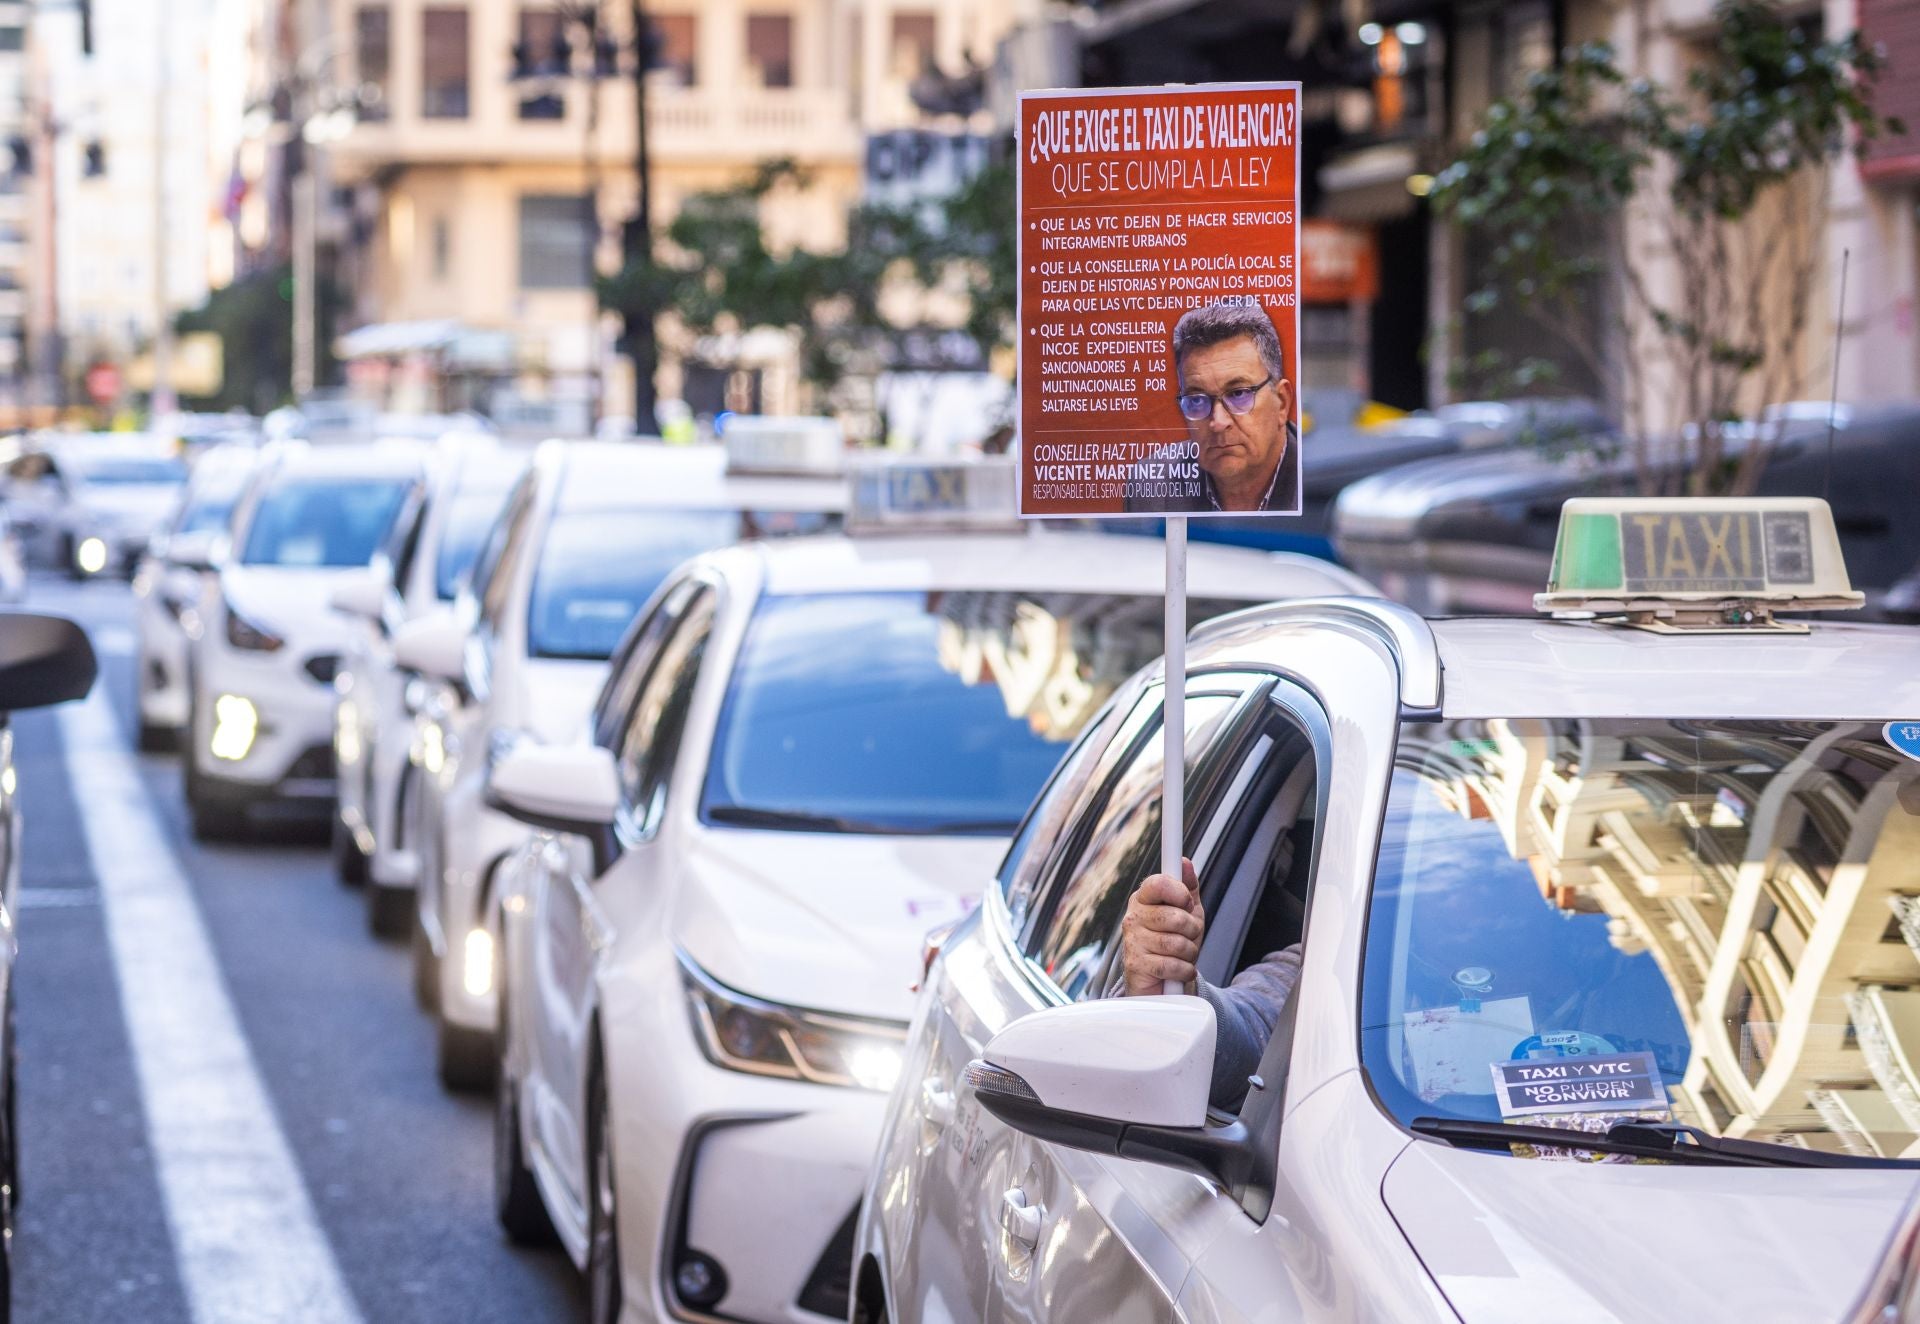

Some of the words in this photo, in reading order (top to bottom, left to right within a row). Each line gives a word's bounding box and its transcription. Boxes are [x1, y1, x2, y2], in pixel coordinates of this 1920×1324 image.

[1030, 110, 1071, 164] ¿QUE
[1075, 108, 1119, 153] EXIGE
[1123, 107, 1140, 151] EL
[1143, 106, 1179, 150] TAXI
[1183, 105, 1204, 149] DE
[1207, 102, 1294, 148] VALENCIA?
[1052, 162, 1092, 198] QUE
[1098, 161, 1119, 192] SE
[1125, 159, 1205, 191] CUMPLA
[1211, 158, 1233, 188] LA
[1239, 156, 1272, 187] LEY
[1040, 218, 1065, 232] QUE
[1071, 217, 1091, 231] LAS
[1096, 216, 1118, 230] VTC
[1124, 215, 1160, 229] DEJEN
[1166, 215, 1182, 228] DE
[1188, 213, 1227, 227] HACER
[1232, 211, 1292, 226] SERVICIOS
[1042, 235, 1129, 250] INTEGRAMENTE
[1132, 234, 1187, 248] URBANOS
[1040, 262, 1064, 276] QUE
[1068, 261, 1082, 274] LA
[1085, 259, 1160, 273] CONSELLERIA
[1163, 258, 1171, 271] Y
[1173, 258, 1187, 271] LA
[1191, 254, 1236, 270] POLICÍA
[1239, 256, 1275, 269] LOCAL
[1279, 255, 1292, 268] SE
[1042, 280, 1077, 294] DEJEN
[1080, 280, 1095, 293] DE
[1099, 278, 1157, 292] HISTORIAS
[1159, 278, 1167, 290] Y
[1170, 276, 1219, 290] PONGAN
[1222, 276, 1244, 289] LOS
[1247, 274, 1292, 288] MEDIOS
[1041, 299, 1070, 312] PARA
[1073, 298, 1097, 313] QUE
[1100, 298, 1120, 311] LAS
[1123, 297, 1145, 311] VTC
[1148, 296, 1184, 310] DEJEN
[1186, 296, 1201, 309] DE
[1204, 295, 1243, 308] HACER
[1246, 294, 1261, 307] DE
[1264, 293, 1295, 307] TAXIS
[1040, 323, 1064, 338] QUE
[1071, 323, 1084, 336] LA
[1090, 321, 1166, 336] CONSELLERIA
[1042, 342, 1079, 356] INCOE
[1087, 340, 1166, 355] EXPEDIENTES
[1042, 360, 1126, 375] SANCIONADORES
[1133, 359, 1140, 373] A
[1148, 359, 1166, 372] LAS
[1042, 379, 1136, 393] MULTINACIONALES
[1145, 378, 1166, 391] POR
[1042, 398, 1087, 413] SALTARSE
[1090, 398, 1108, 412] LAS
[1110, 397, 1138, 411] LEYES
[1034, 443, 1099, 462] CONSELLER
[1102, 442, 1126, 460] HAZ
[1128, 442, 1145, 460] TU
[1147, 441, 1200, 460] TRABAJO
[1035, 464, 1091, 481] VICENTE
[1095, 463, 1165, 480] MARTINEZ
[1168, 463, 1199, 479] MUS
[1033, 483, 1084, 500] RESPONSABLE
[1085, 483, 1100, 499] DEL
[1101, 482, 1134, 498] SERVICIO
[1135, 479, 1168, 498] PÚBLICO
[1169, 482, 1184, 498] DEL
[1185, 481, 1200, 497] TAXI
[1632, 514, 1755, 578] TAXI
[1519, 1066, 1567, 1080] TAXI
[1572, 1065, 1585, 1076] Y
[1588, 1062, 1632, 1075] VTC
[1524, 1085, 1554, 1097] NO
[1560, 1080, 1635, 1092] PUEDEN
[1535, 1089, 1630, 1103] CONVIVIR
